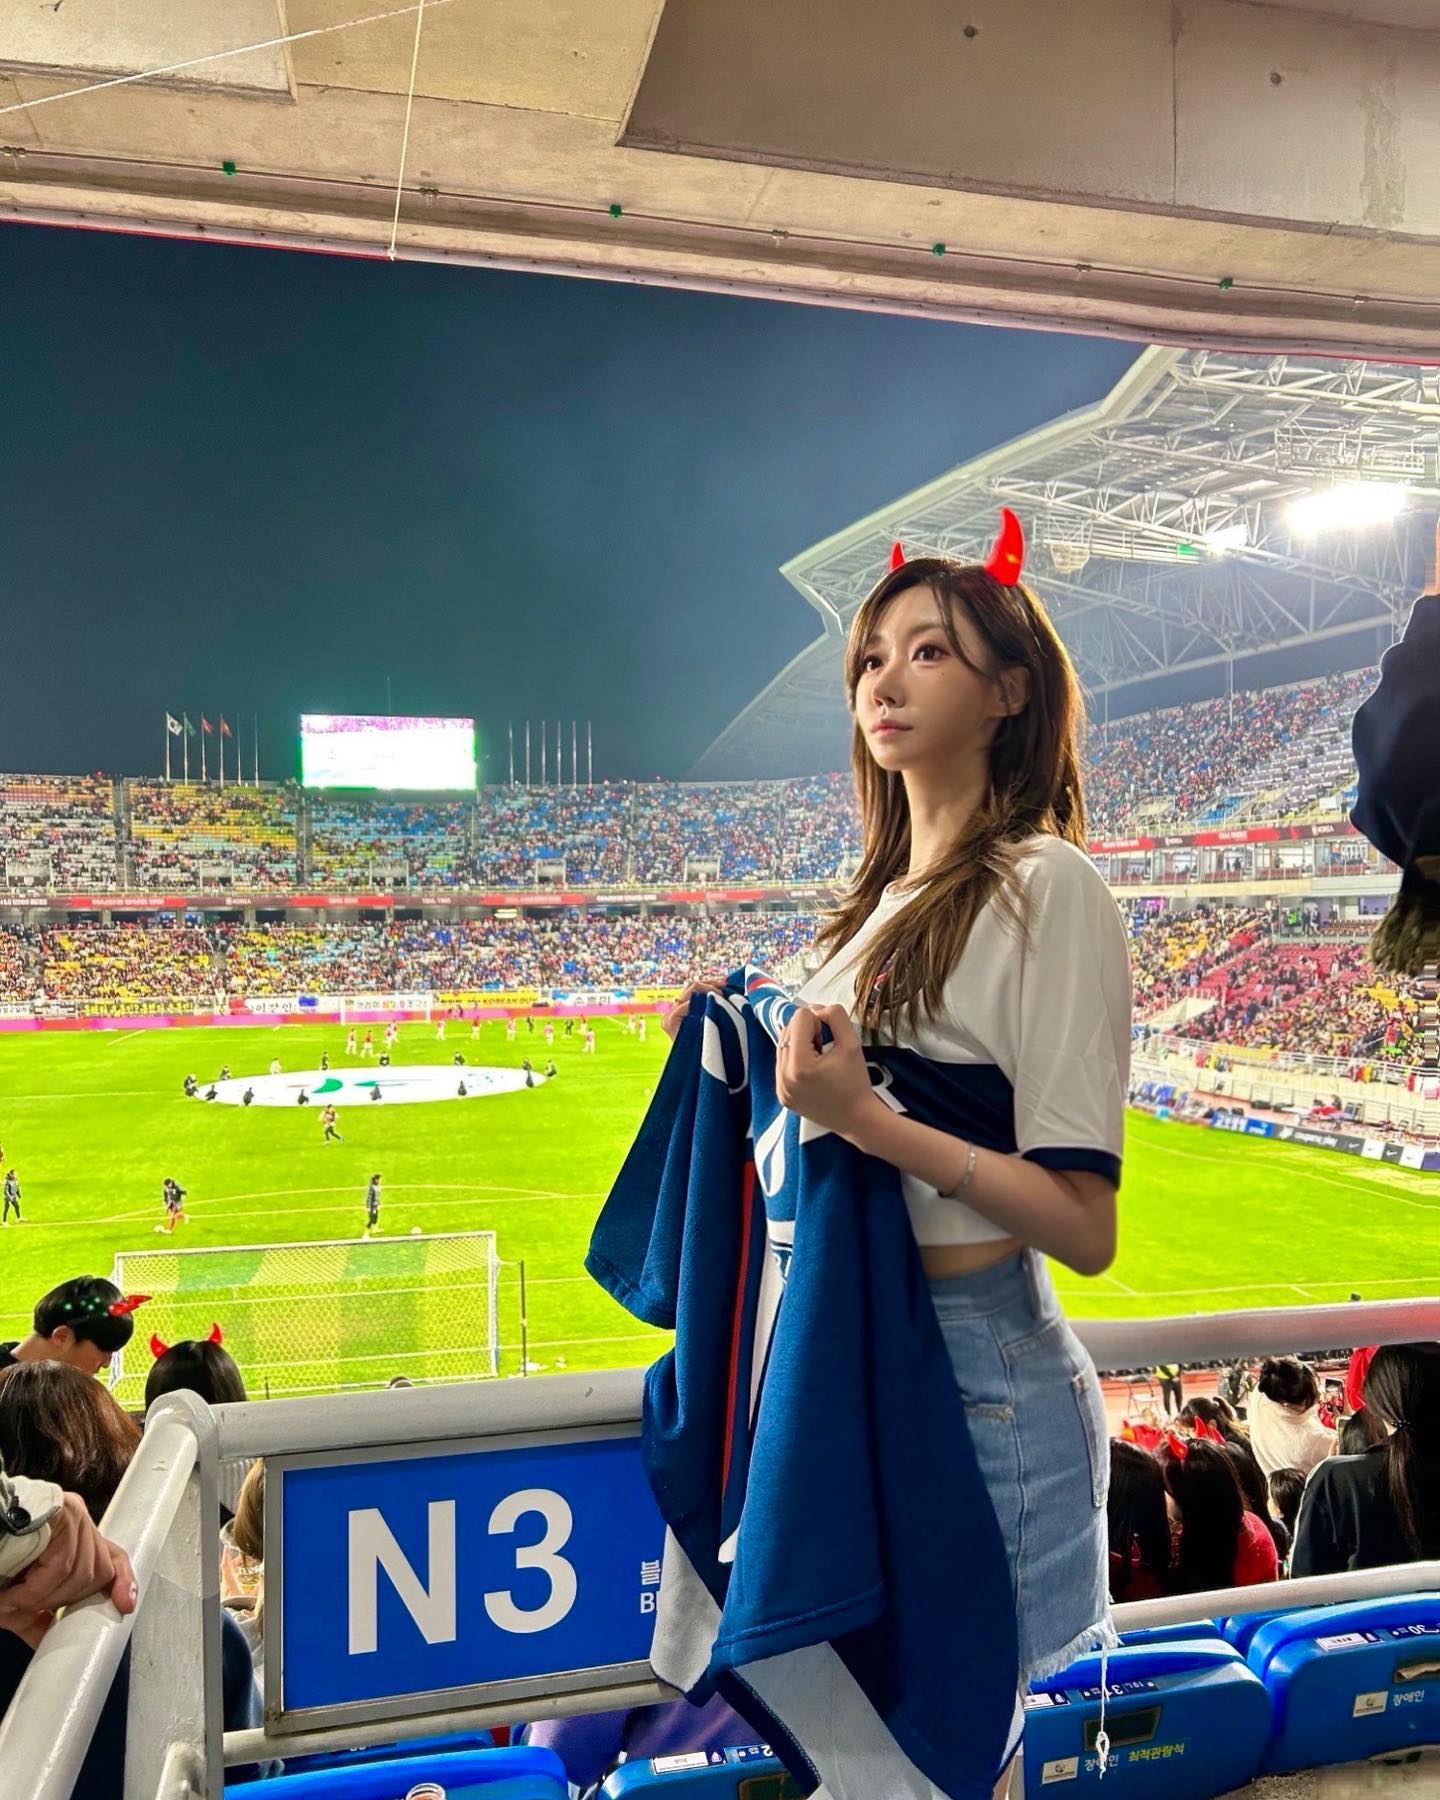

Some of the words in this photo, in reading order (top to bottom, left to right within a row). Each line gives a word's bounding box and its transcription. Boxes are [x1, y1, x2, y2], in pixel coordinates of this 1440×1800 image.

[348, 1488, 578, 1656] N3
[1392, 1690, 1425, 1707] 장애인
[1128, 1743, 1185, 1762] 최적관람석
